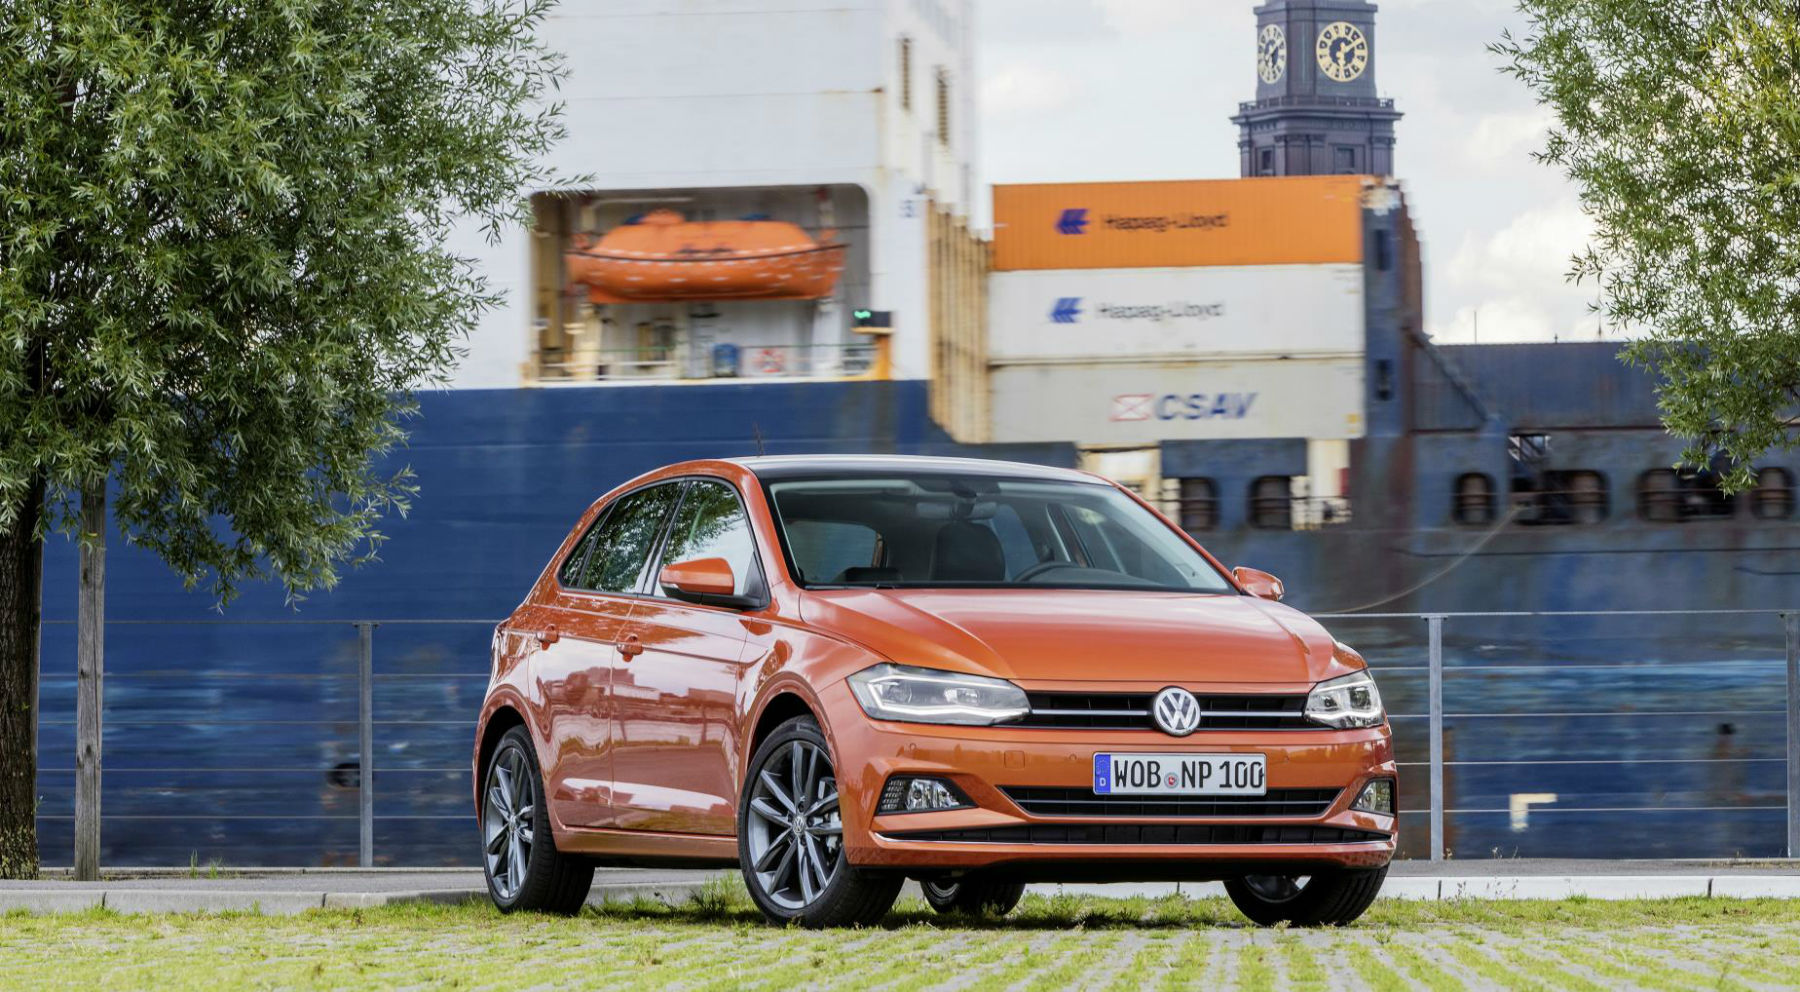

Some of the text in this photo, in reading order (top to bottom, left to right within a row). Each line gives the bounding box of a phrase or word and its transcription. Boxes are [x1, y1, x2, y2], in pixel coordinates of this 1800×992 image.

[1155, 393, 1258, 420] CSAV
[1154, 686, 1201, 735] VW
[1099, 777, 1107, 787] D
[1114, 760, 1265, 788] WOB NP 100
